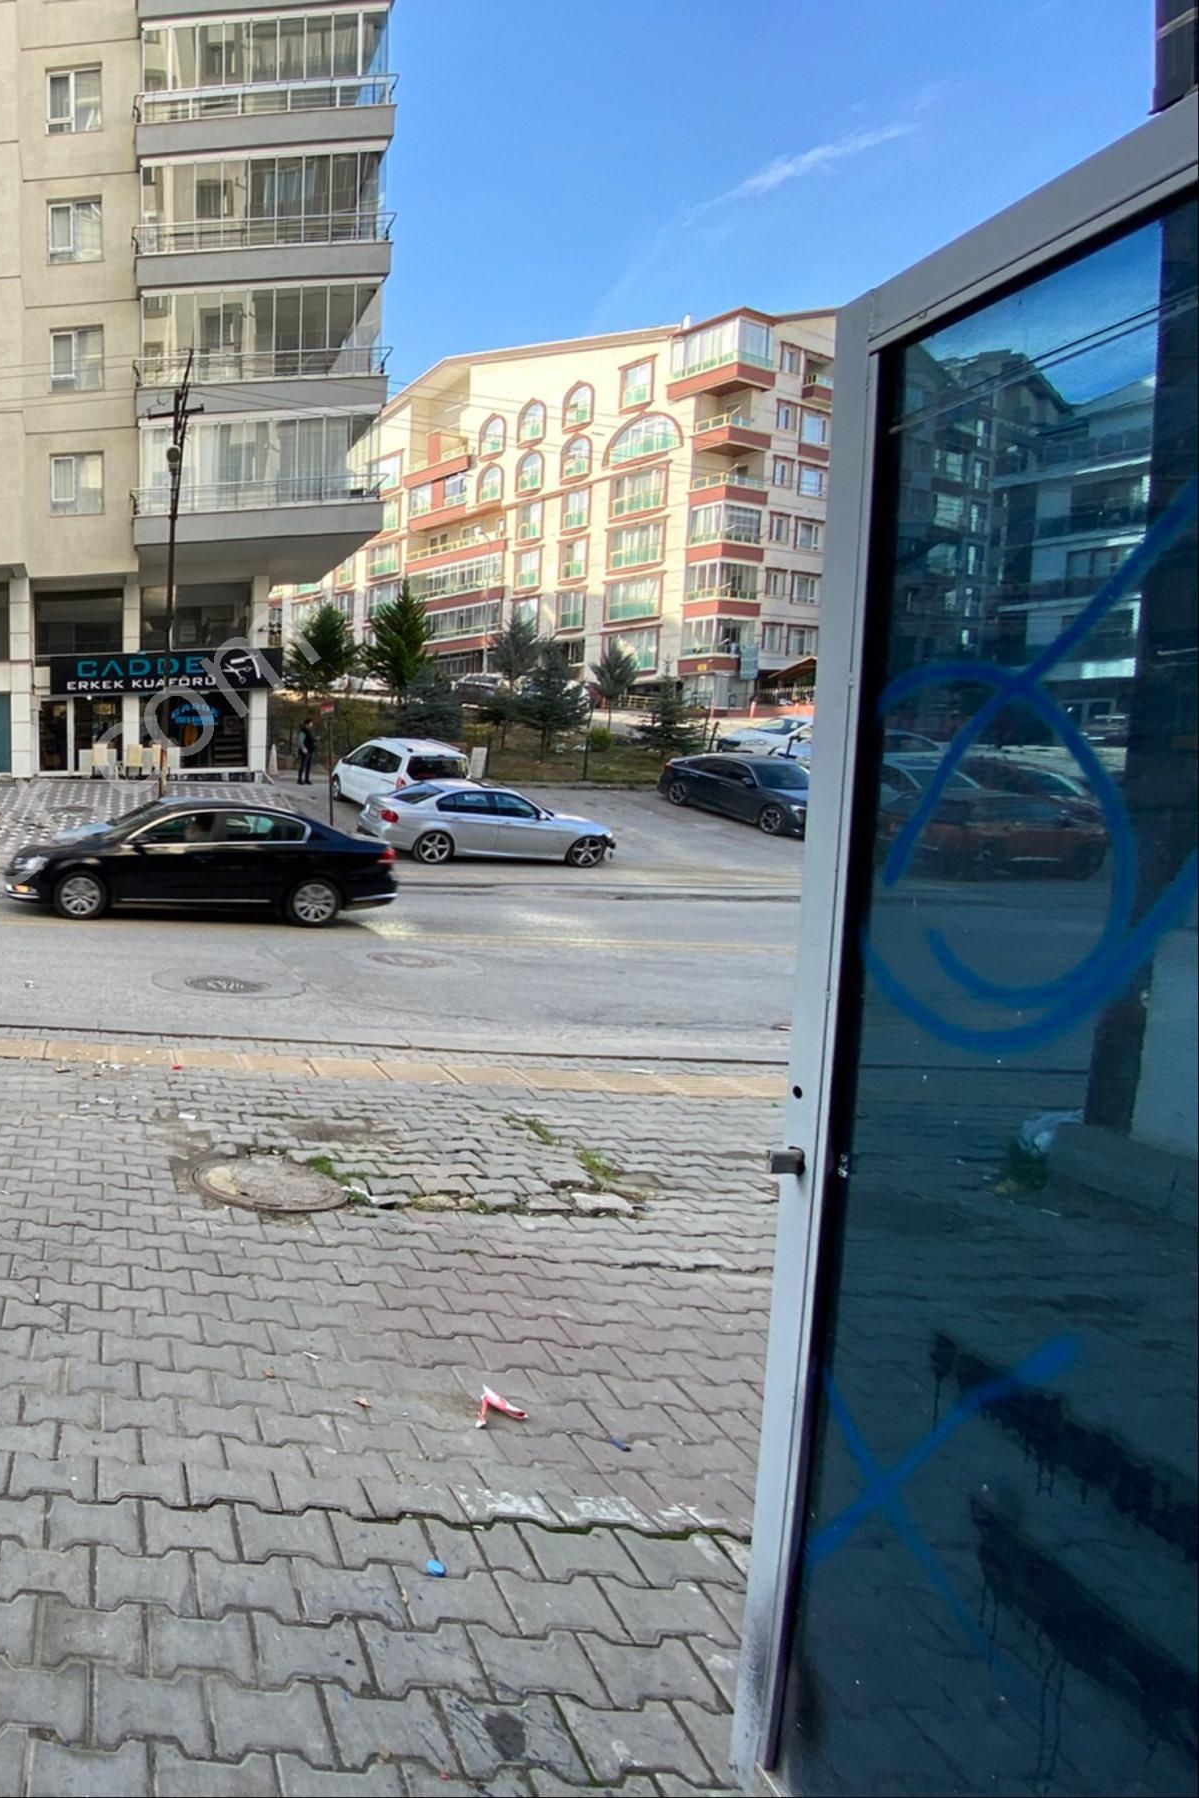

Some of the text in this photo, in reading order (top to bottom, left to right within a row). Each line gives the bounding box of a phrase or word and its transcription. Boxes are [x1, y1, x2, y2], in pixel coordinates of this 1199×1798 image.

[76, 655, 207, 678] CADDE
[66, 674, 217, 691] ERKEK KUAFÖRÜ
